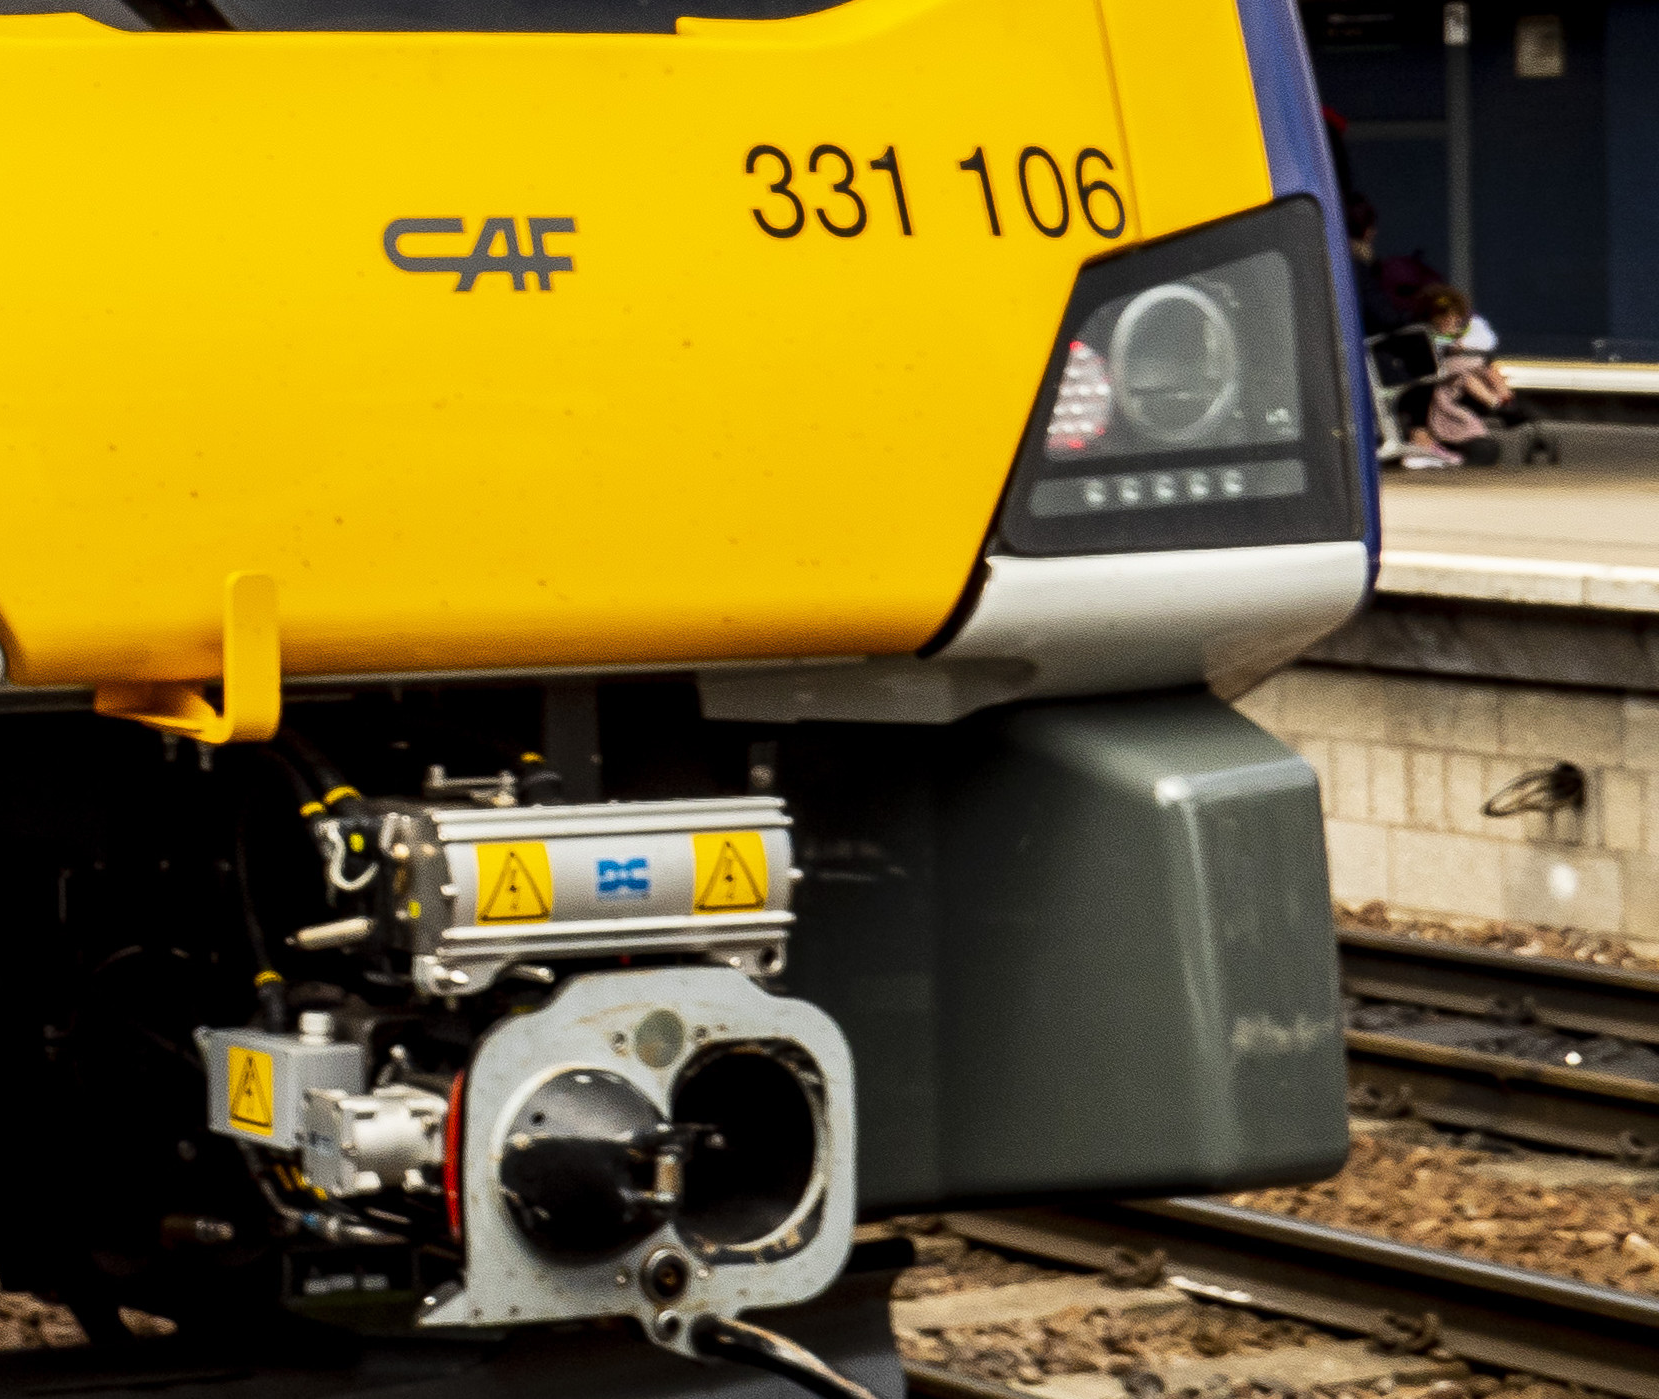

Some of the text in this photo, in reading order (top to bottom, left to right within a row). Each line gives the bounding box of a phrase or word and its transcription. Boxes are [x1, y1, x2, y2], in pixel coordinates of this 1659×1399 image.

[745, 144, 1127, 240] 331 106
[383, 217, 576, 292] CAF
